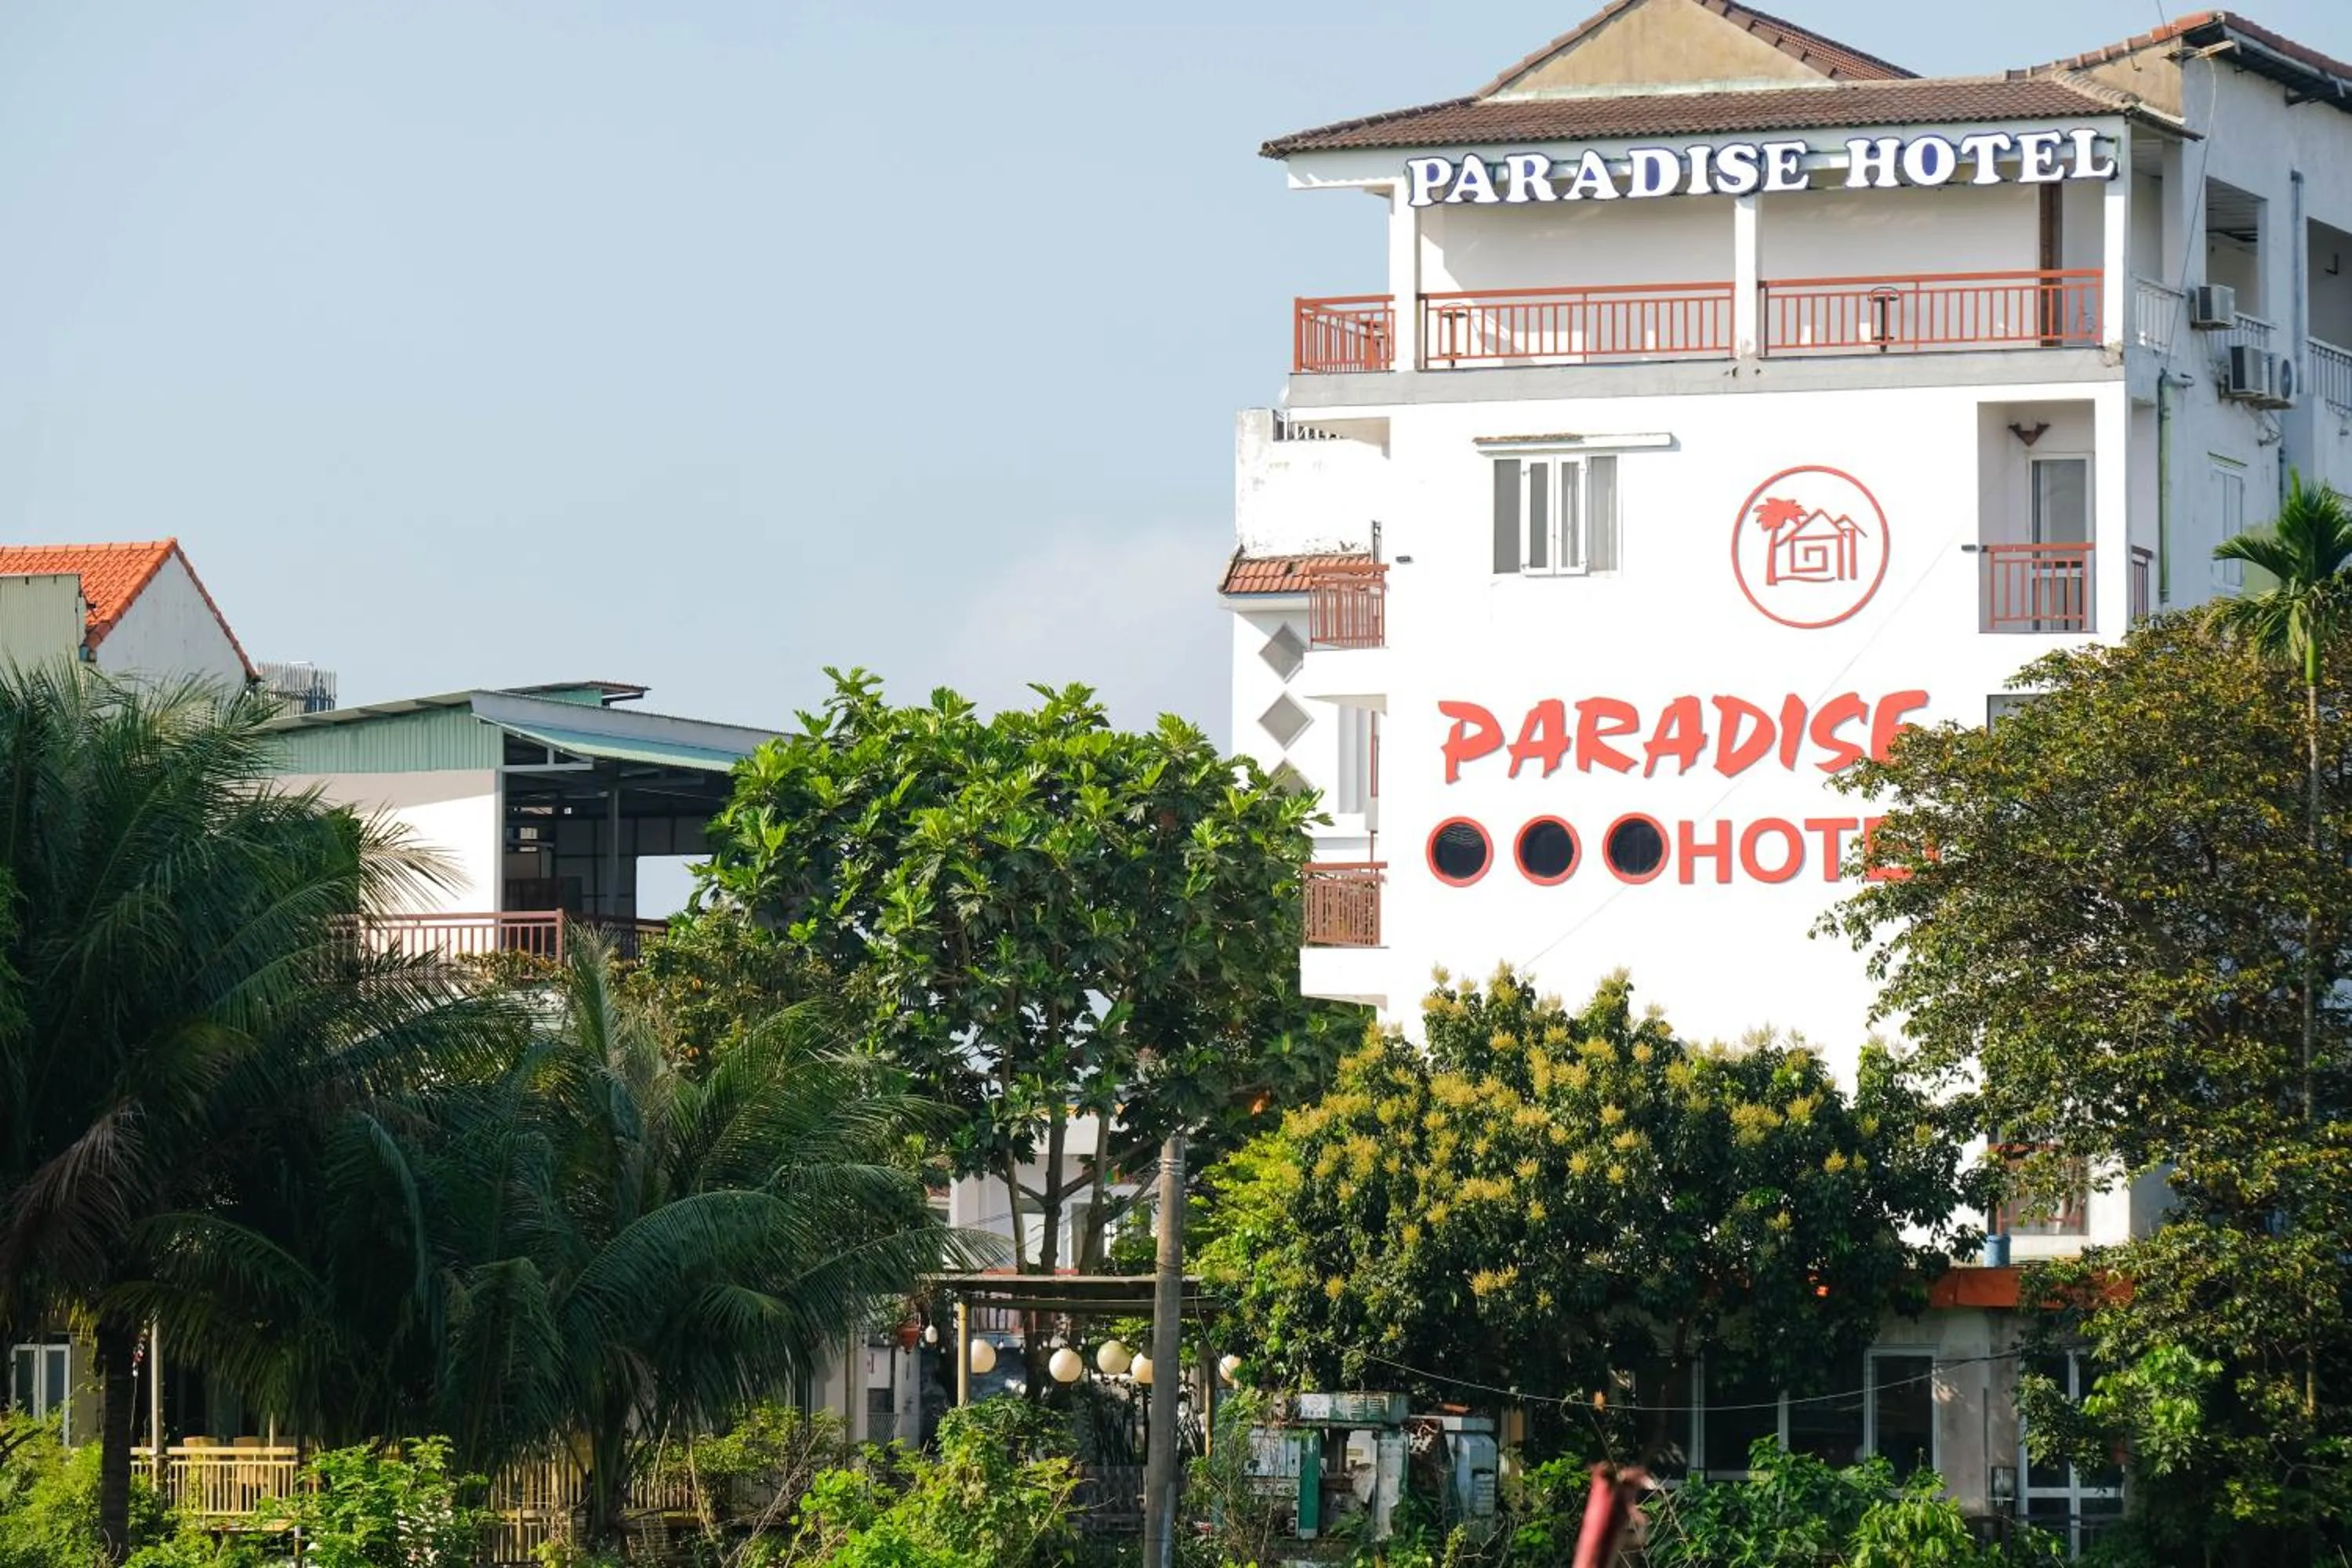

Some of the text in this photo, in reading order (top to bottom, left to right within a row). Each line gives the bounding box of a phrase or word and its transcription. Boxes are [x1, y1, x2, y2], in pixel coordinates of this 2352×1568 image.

[1406, 127, 2118, 207] PARADISE HOTEL
[1438, 689, 1930, 785] PARADISE
